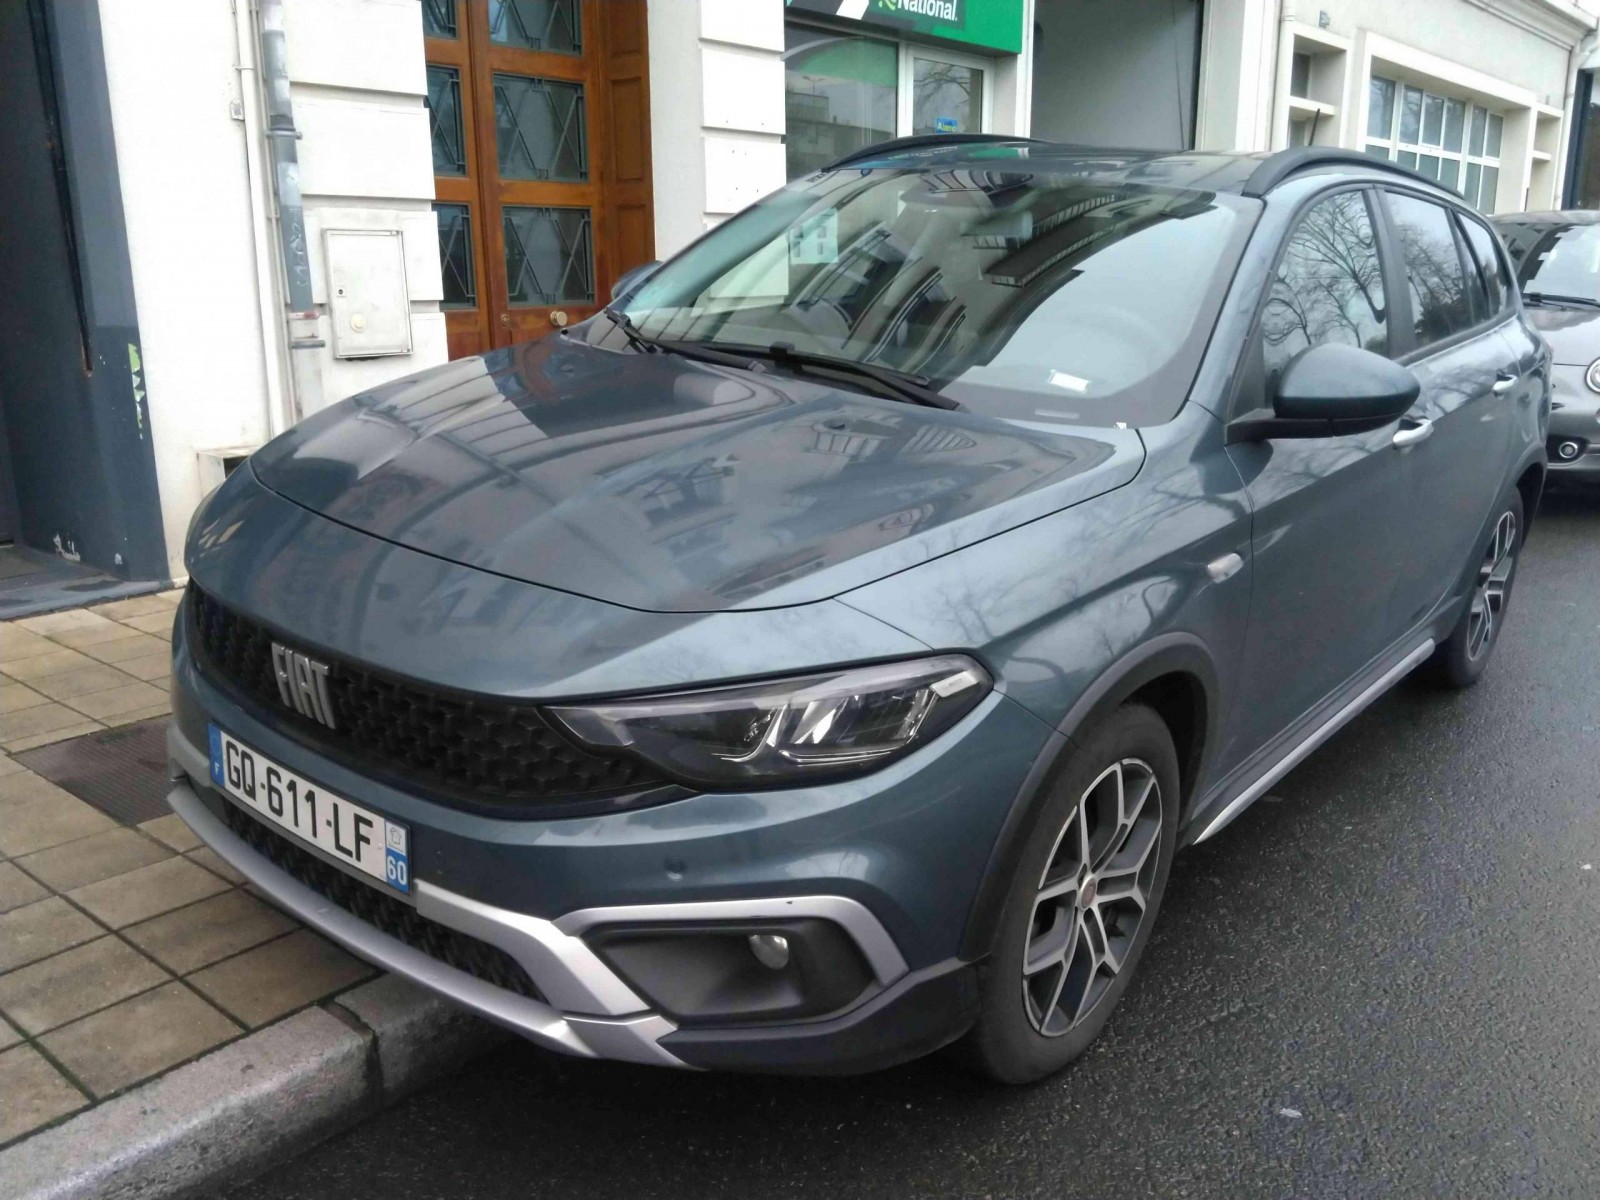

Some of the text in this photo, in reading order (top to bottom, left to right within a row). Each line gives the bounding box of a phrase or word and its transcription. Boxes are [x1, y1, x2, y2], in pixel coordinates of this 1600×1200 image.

[271, 642, 336, 730] FIAT
[214, 761, 220, 775] F
[225, 740, 373, 862] GQ-611-LF
[387, 856, 407, 885] 60
